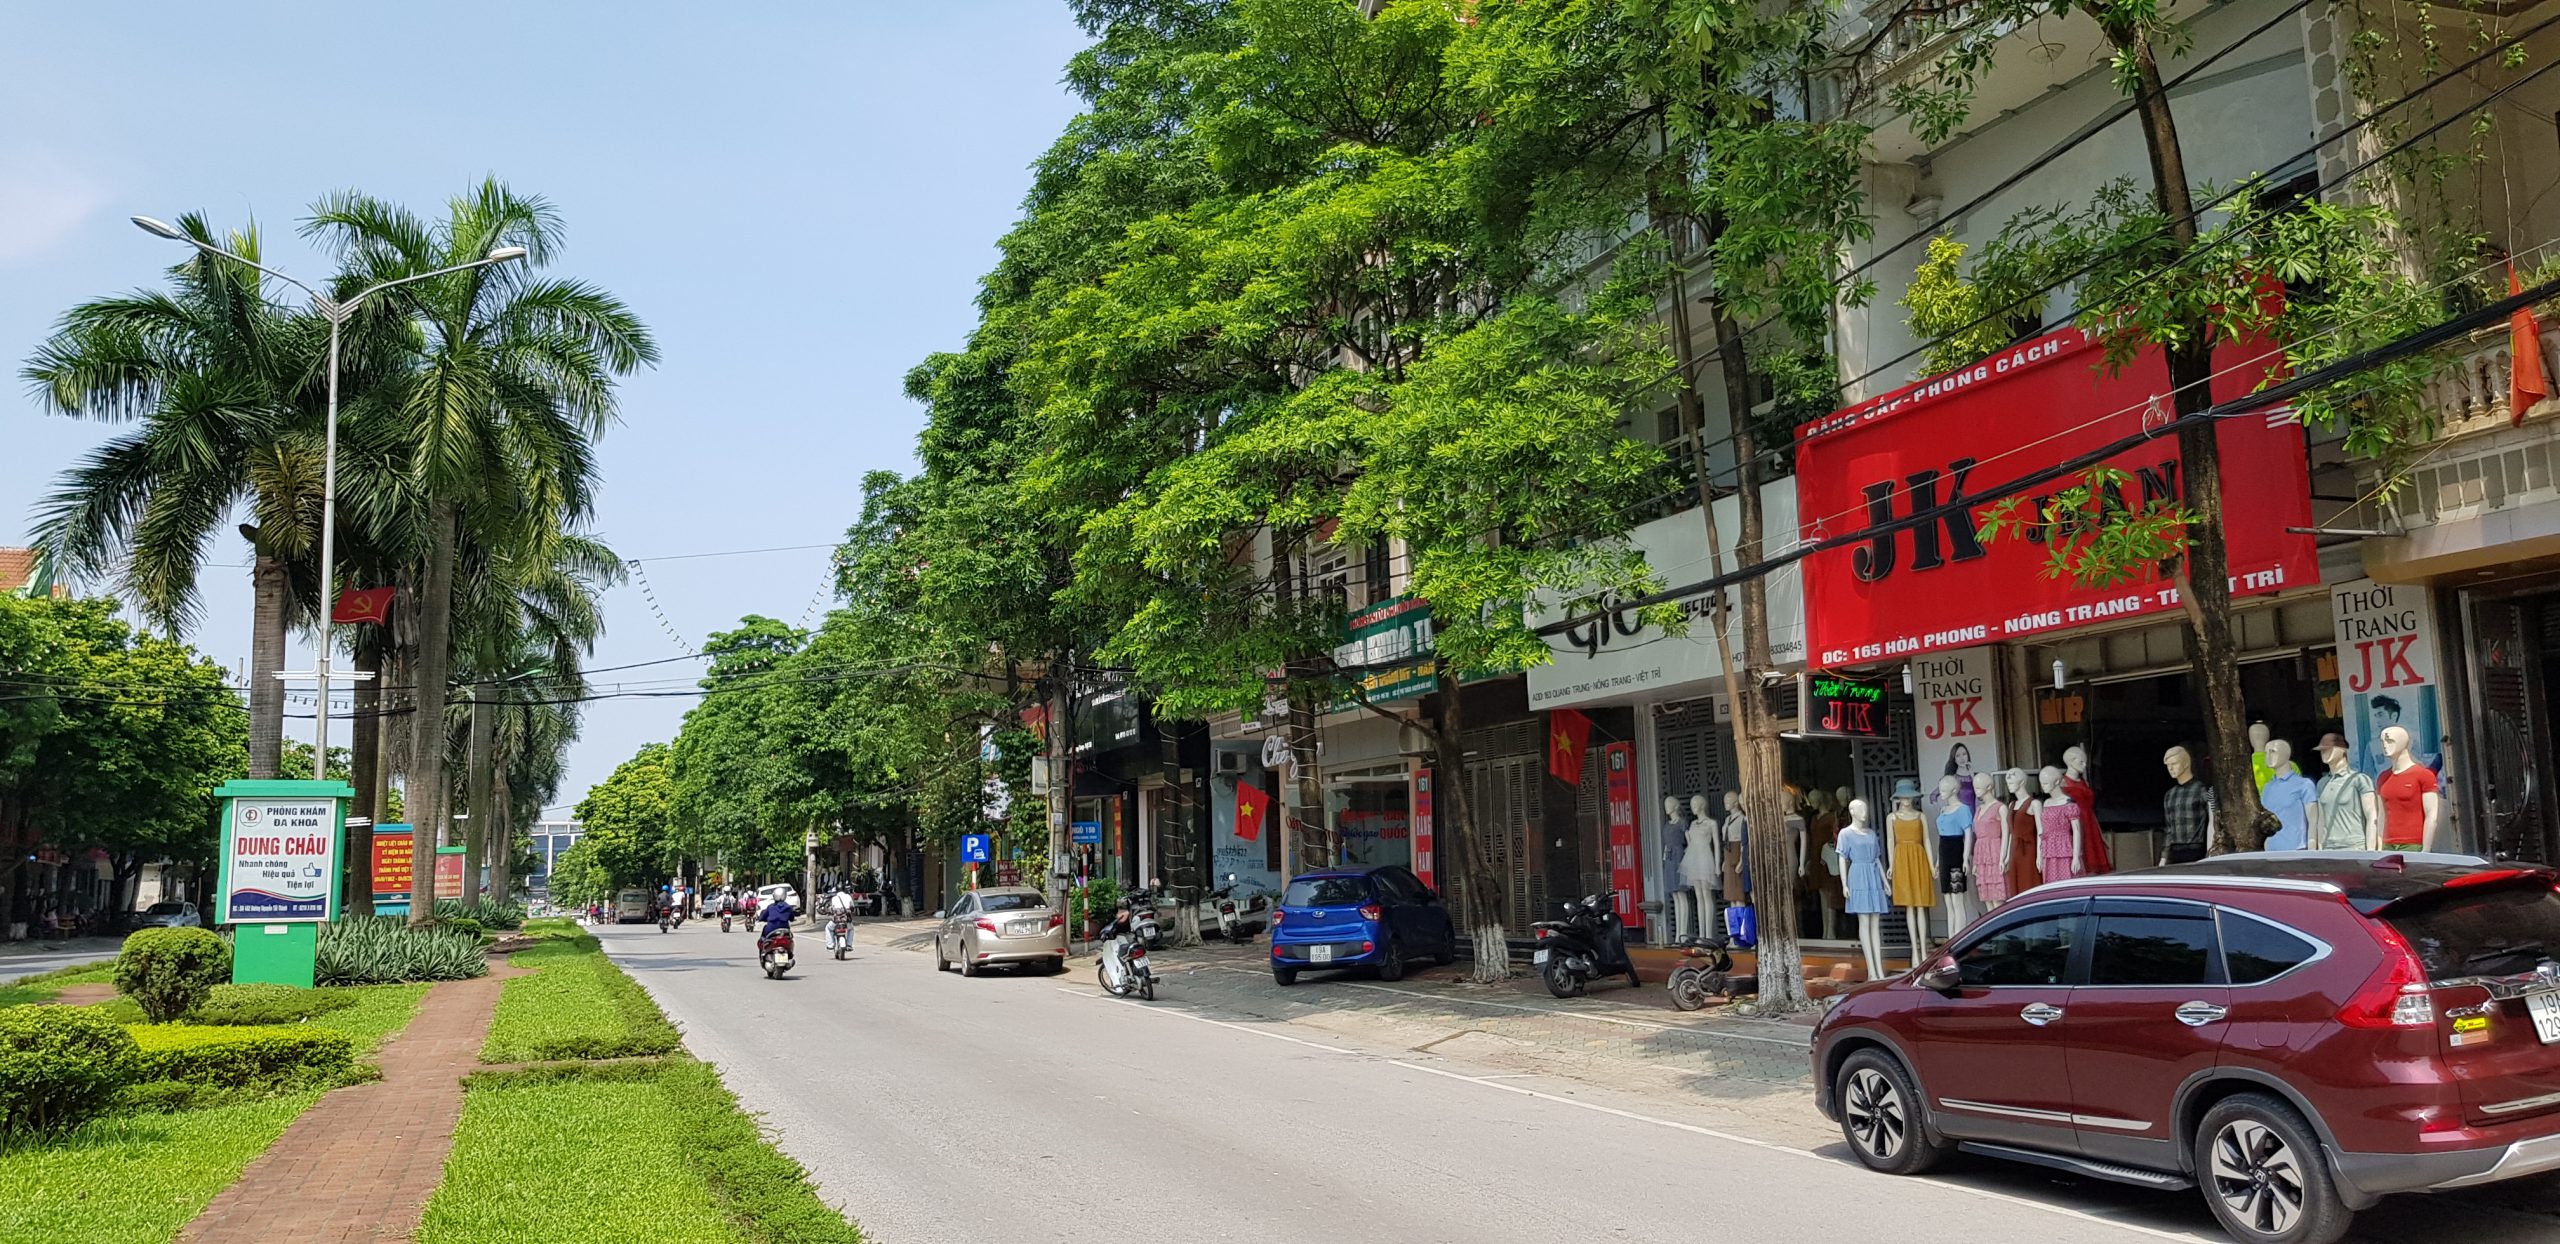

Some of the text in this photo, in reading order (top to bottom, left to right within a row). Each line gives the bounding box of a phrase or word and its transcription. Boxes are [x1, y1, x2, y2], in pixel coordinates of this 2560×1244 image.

[1851, 455, 1986, 582] JK
[2336, 584, 2394, 615] THỜI
[1822, 648, 1848, 665] ĐC:
[1852, 642, 1882, 661] 165
[1885, 632, 1919, 655] HÒA
[1923, 623, 1986, 648] PHONG
[2004, 608, 2061, 634] NÔNG
[2064, 594, 2140, 622] TRANG
[2242, 563, 2285, 590] TRÌ
[2339, 610, 2417, 641] TRANG
[1918, 658, 1965, 680] THỜI
[2349, 633, 2425, 692] JK
[1611, 674, 1632, 687] TRANG
[1918, 678, 1982, 700] TRANG
[1822, 701, 1873, 731] JK
[1925, 696, 1987, 740] JK
[1611, 752, 1625, 770] 161
[267, 806, 327, 816] PHÒNG KHÁM
[274, 819, 319, 827] ĐA KHOA
[238, 833, 327, 855] DUNG CHÂU
[967, 838, 979, 853] P
[238, 860, 288, 869] Nhanh chóng
[262, 870, 280, 879] Hiệu
[287, 881, 303, 890] Tiện
